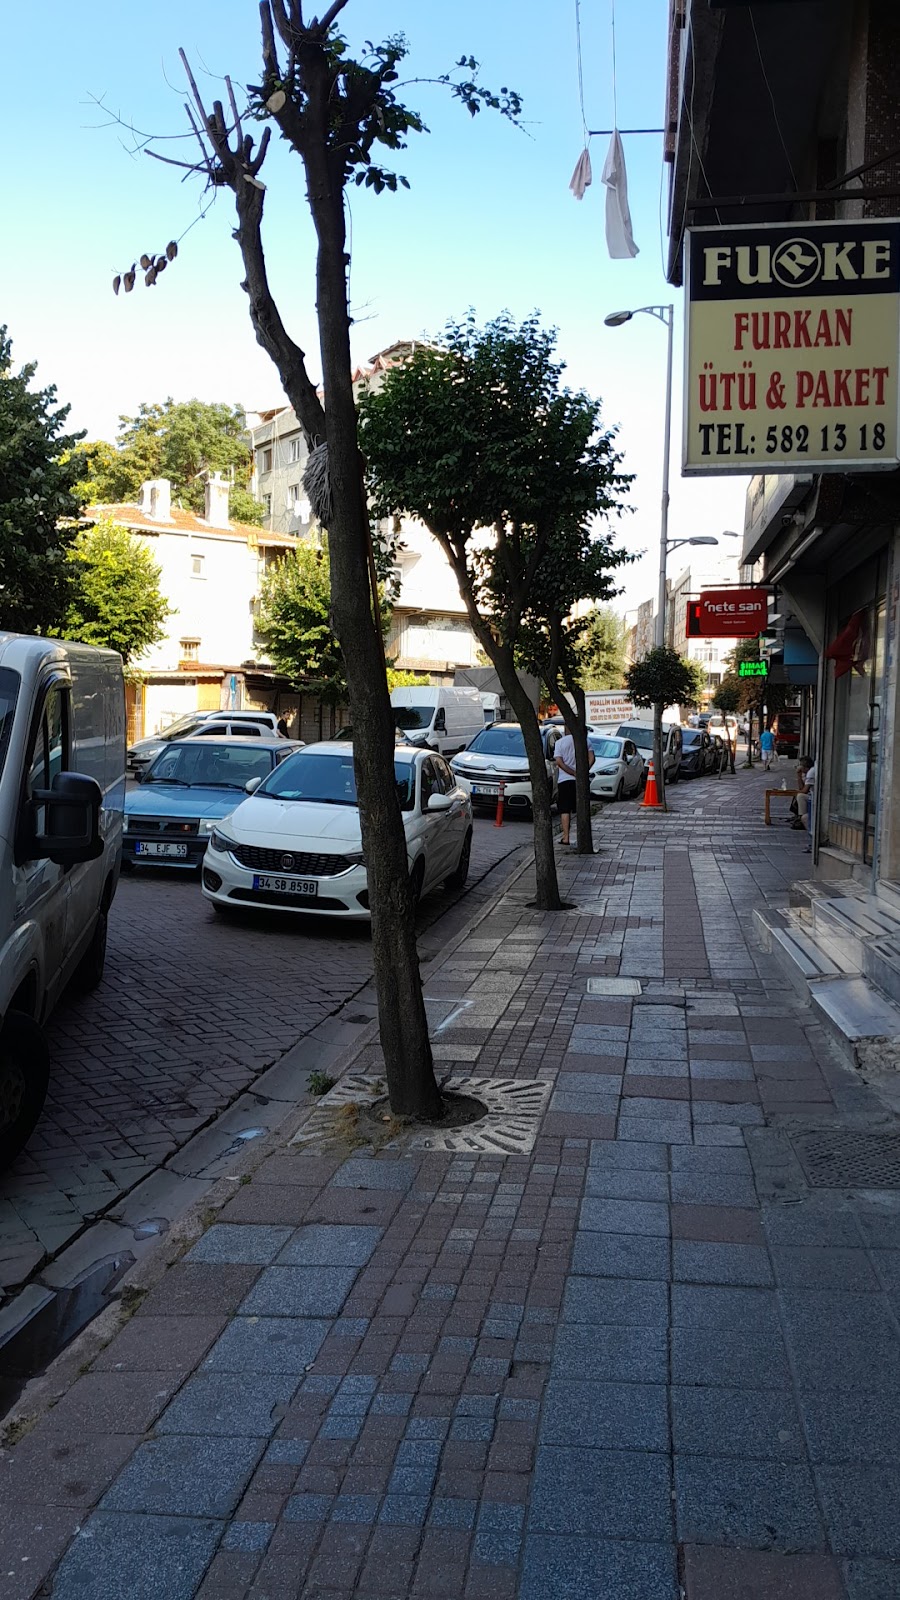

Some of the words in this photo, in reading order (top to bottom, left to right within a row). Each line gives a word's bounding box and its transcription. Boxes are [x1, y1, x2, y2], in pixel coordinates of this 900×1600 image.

[702, 237, 891, 288] FURKE
[733, 308, 853, 351] FURKAN
[698, 360, 757, 412] ÜTÜ
[765, 371, 787, 410] &
[795, 366, 889, 409] PAKET
[698, 423, 756, 455] TEL:
[765, 424, 809, 453] 582
[820, 423, 847, 452] 13
[859, 422, 886, 451] 18
[140, 843, 149, 852] 34
[176, 845, 186, 854] 55
[259, 878, 271, 889] 34
[274, 879, 287, 891] SB
[290, 881, 315, 894] 8598
